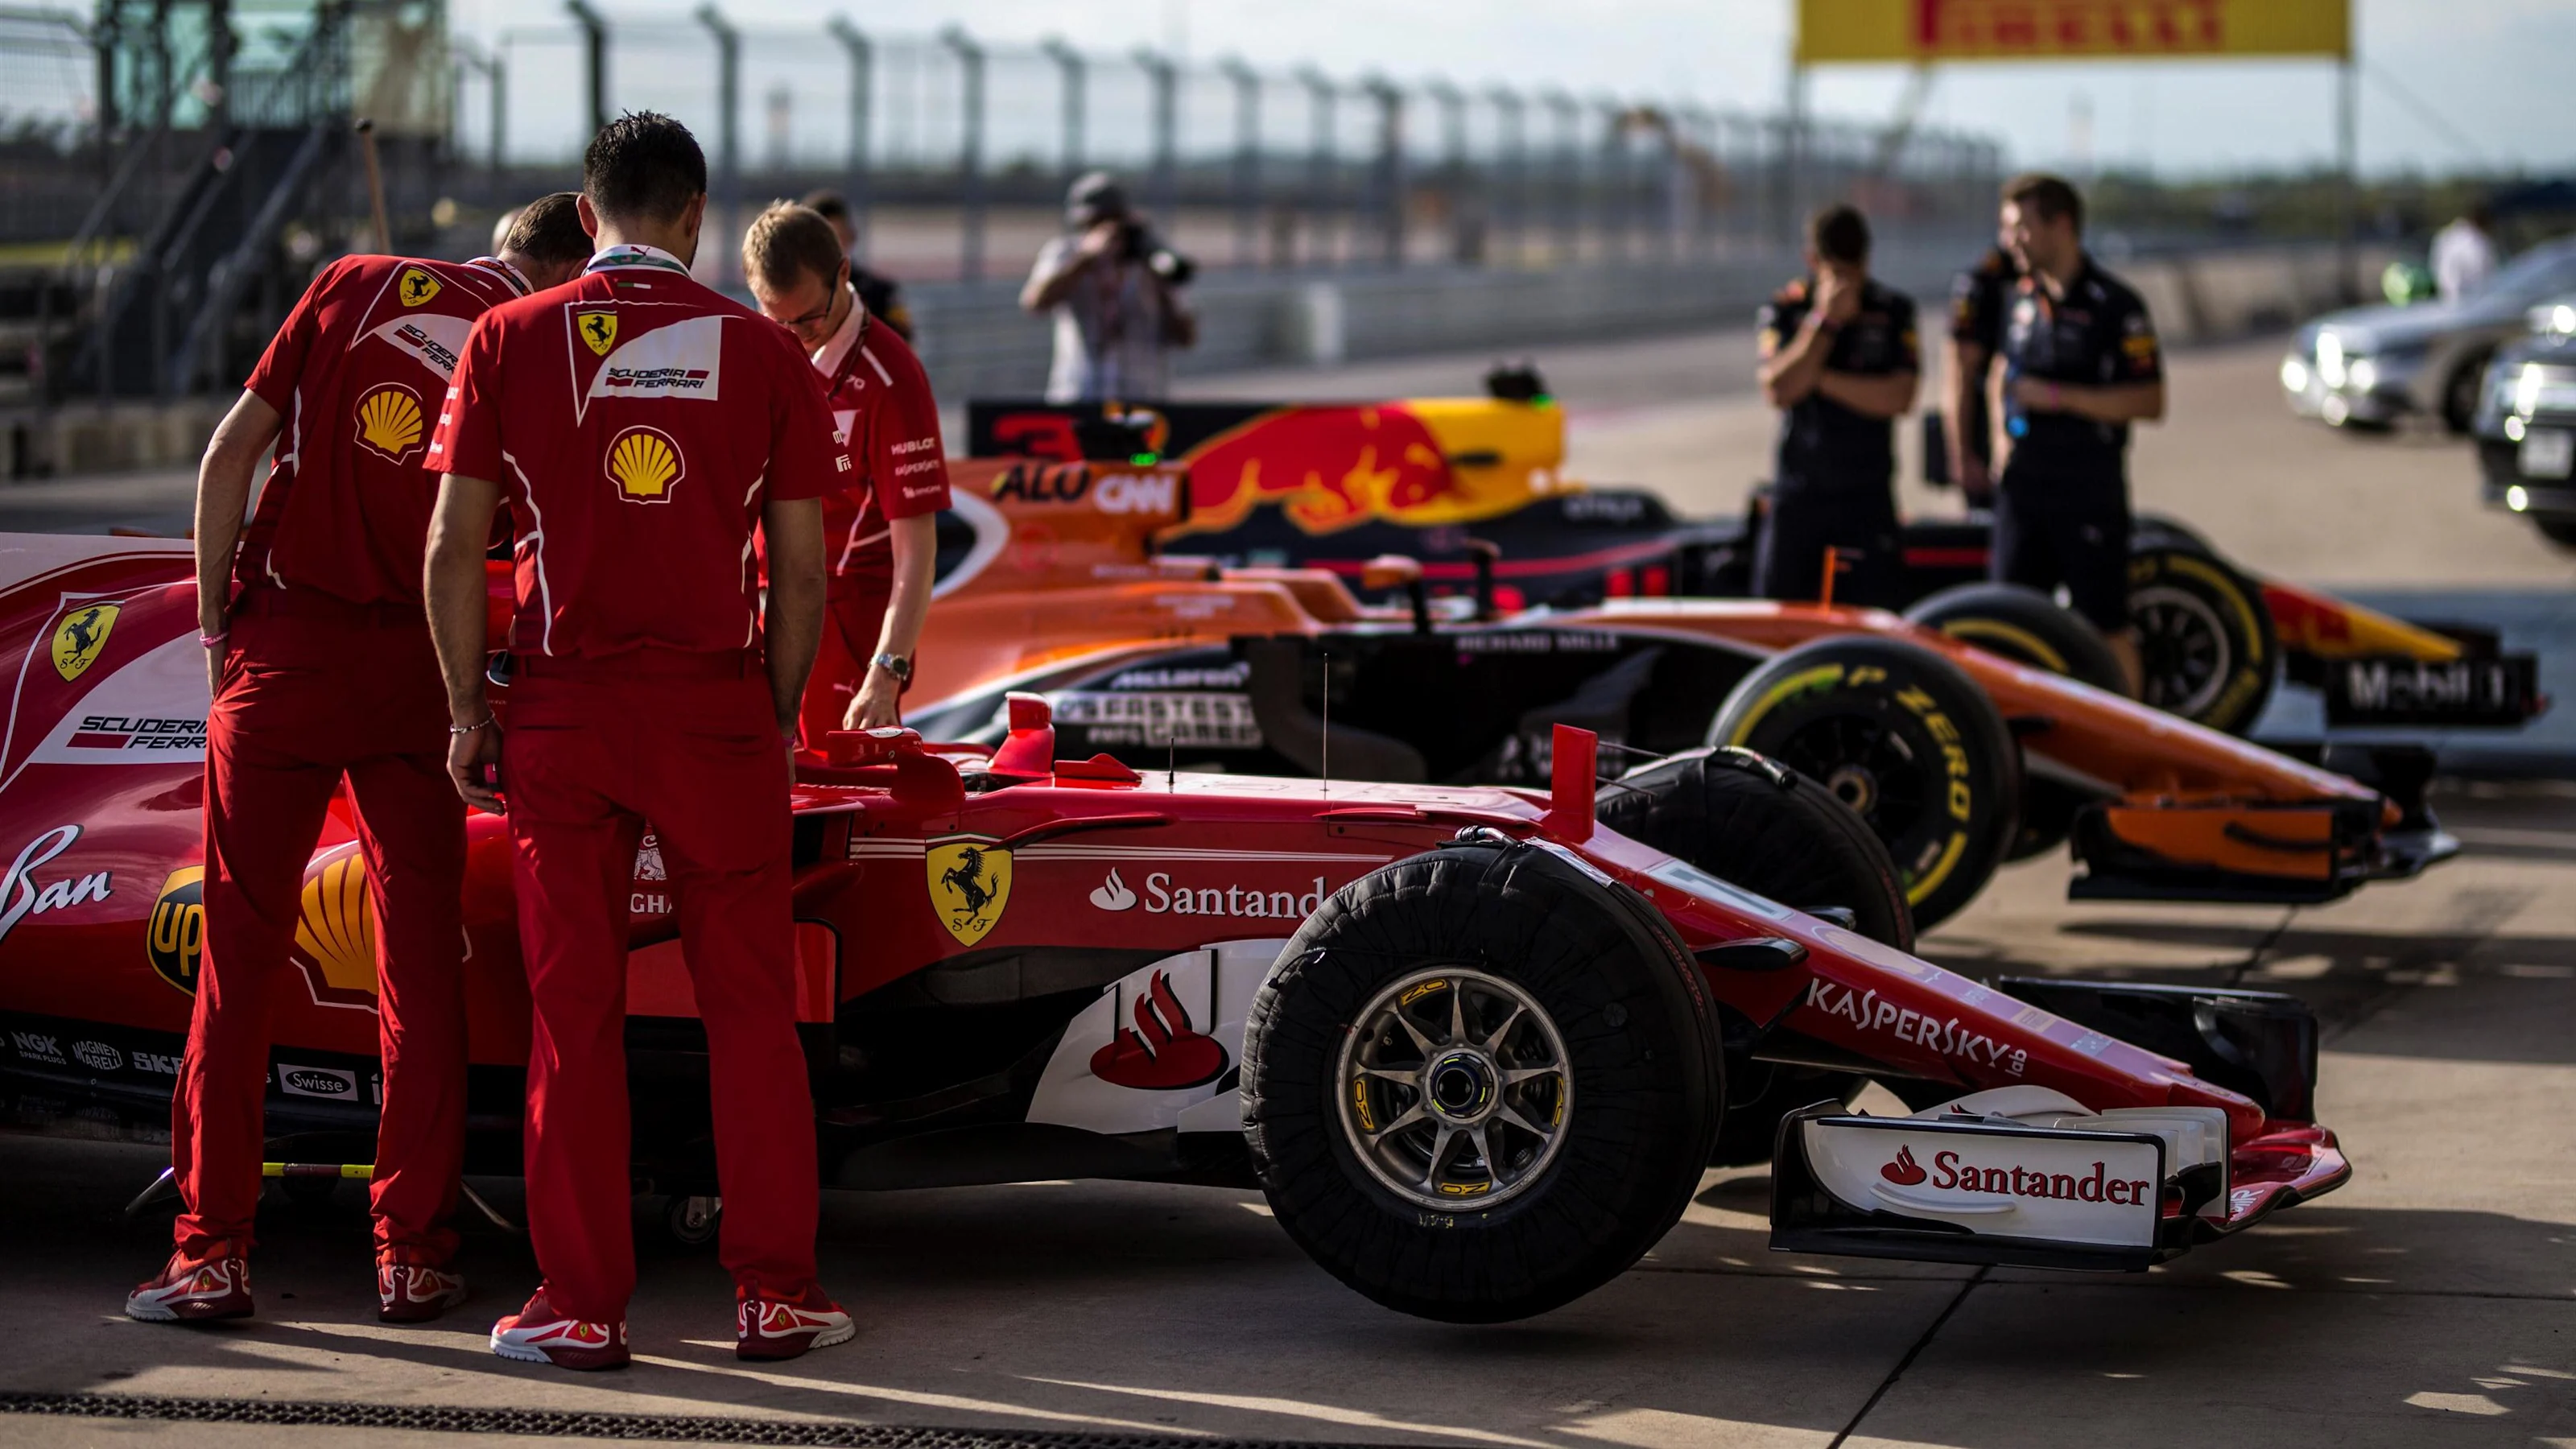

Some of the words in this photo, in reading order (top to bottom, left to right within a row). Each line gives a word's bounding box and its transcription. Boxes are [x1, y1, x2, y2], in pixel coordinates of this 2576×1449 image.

[402, 324, 459, 365] SCUDER
[608, 368, 686, 378] SCUDERIA
[634, 378, 704, 388] FERRARI
[890, 437, 935, 455] HUBLOT
[1093, 473, 1177, 513] CNN
[2347, 660, 2470, 708] Mobil
[79, 716, 207, 733] SCUDERI
[127, 736, 206, 749] FERR
[1895, 683, 1971, 823] ZERO
[0, 824, 112, 943] Ban
[1145, 872, 1327, 919] Santand
[154, 902, 204, 976] up
[1806, 977, 2011, 1069] KASPERSKY
[2004, 1048, 2028, 1077] lab
[10, 1031, 62, 1056] NGK
[19, 1050, 43, 1062] SPARK
[43, 1055, 67, 1065] PLUGS
[72, 1040, 122, 1063] MAGNETI
[293, 1073, 344, 1092] Swisse
[1933, 1150, 2150, 1206] Santander
